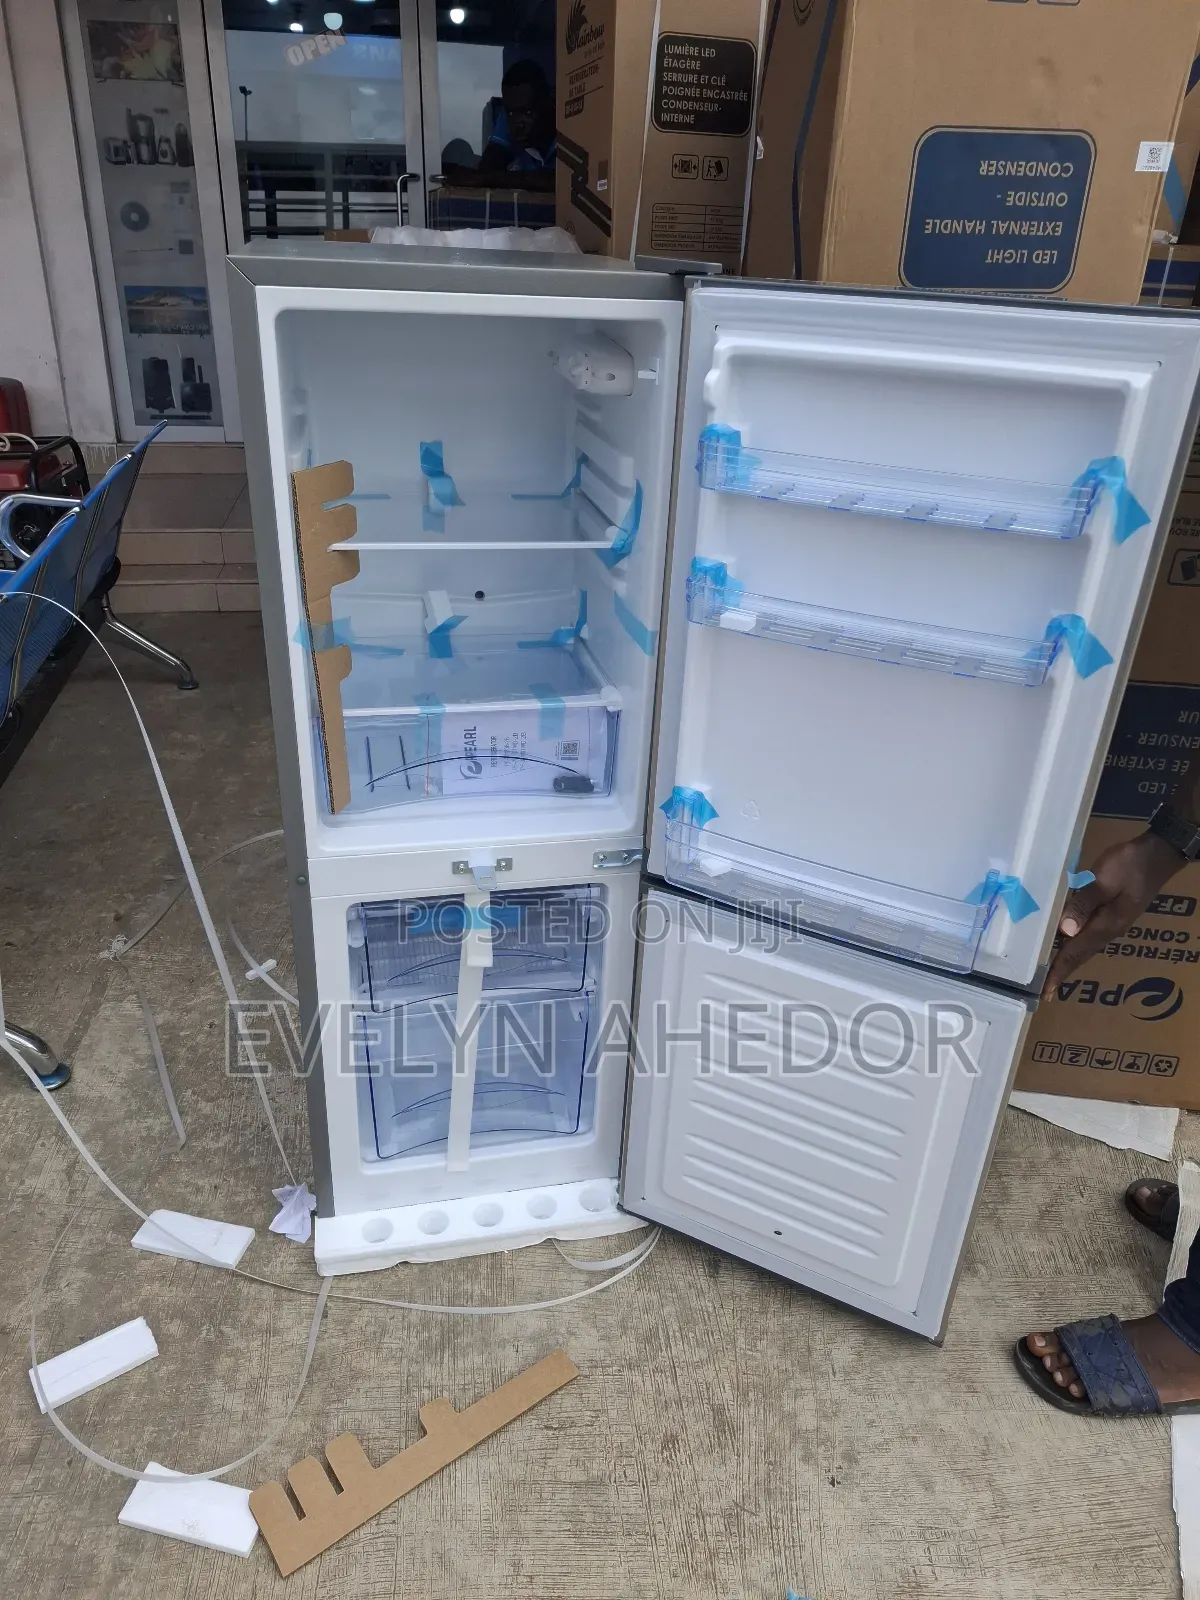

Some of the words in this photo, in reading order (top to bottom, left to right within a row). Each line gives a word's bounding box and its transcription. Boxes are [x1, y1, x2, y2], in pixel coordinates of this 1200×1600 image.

[285, 28, 347, 66] OPEN
[664, 43, 699, 56] LUMIÈRE
[701, 47, 716, 58] LED
[662, 72, 698, 83] SERRURE
[700, 75, 709, 84] ET
[711, 74, 726, 86] CLÉ
[662, 85, 701, 97] POIGNÉE
[702, 88, 748, 101] ENCASTRÉE
[661, 113, 695, 124] INTERNE
[979, 160, 1074, 177] CONDENSER
[1005, 191, 1069, 207] OUTSIDE
[924, 218, 986, 234] HANDLE
[991, 220, 1063, 236] EXTERNAL
[985, 249, 1027, 264] LIGHT
[1032, 250, 1058, 265] LED
[463, 725, 477, 761] PEARL
[1137, 732, 1200, 749] ENSUER
[1137, 780, 1167, 794] LED
[1100, 943, 1200, 964] RÉFRIGÉ
